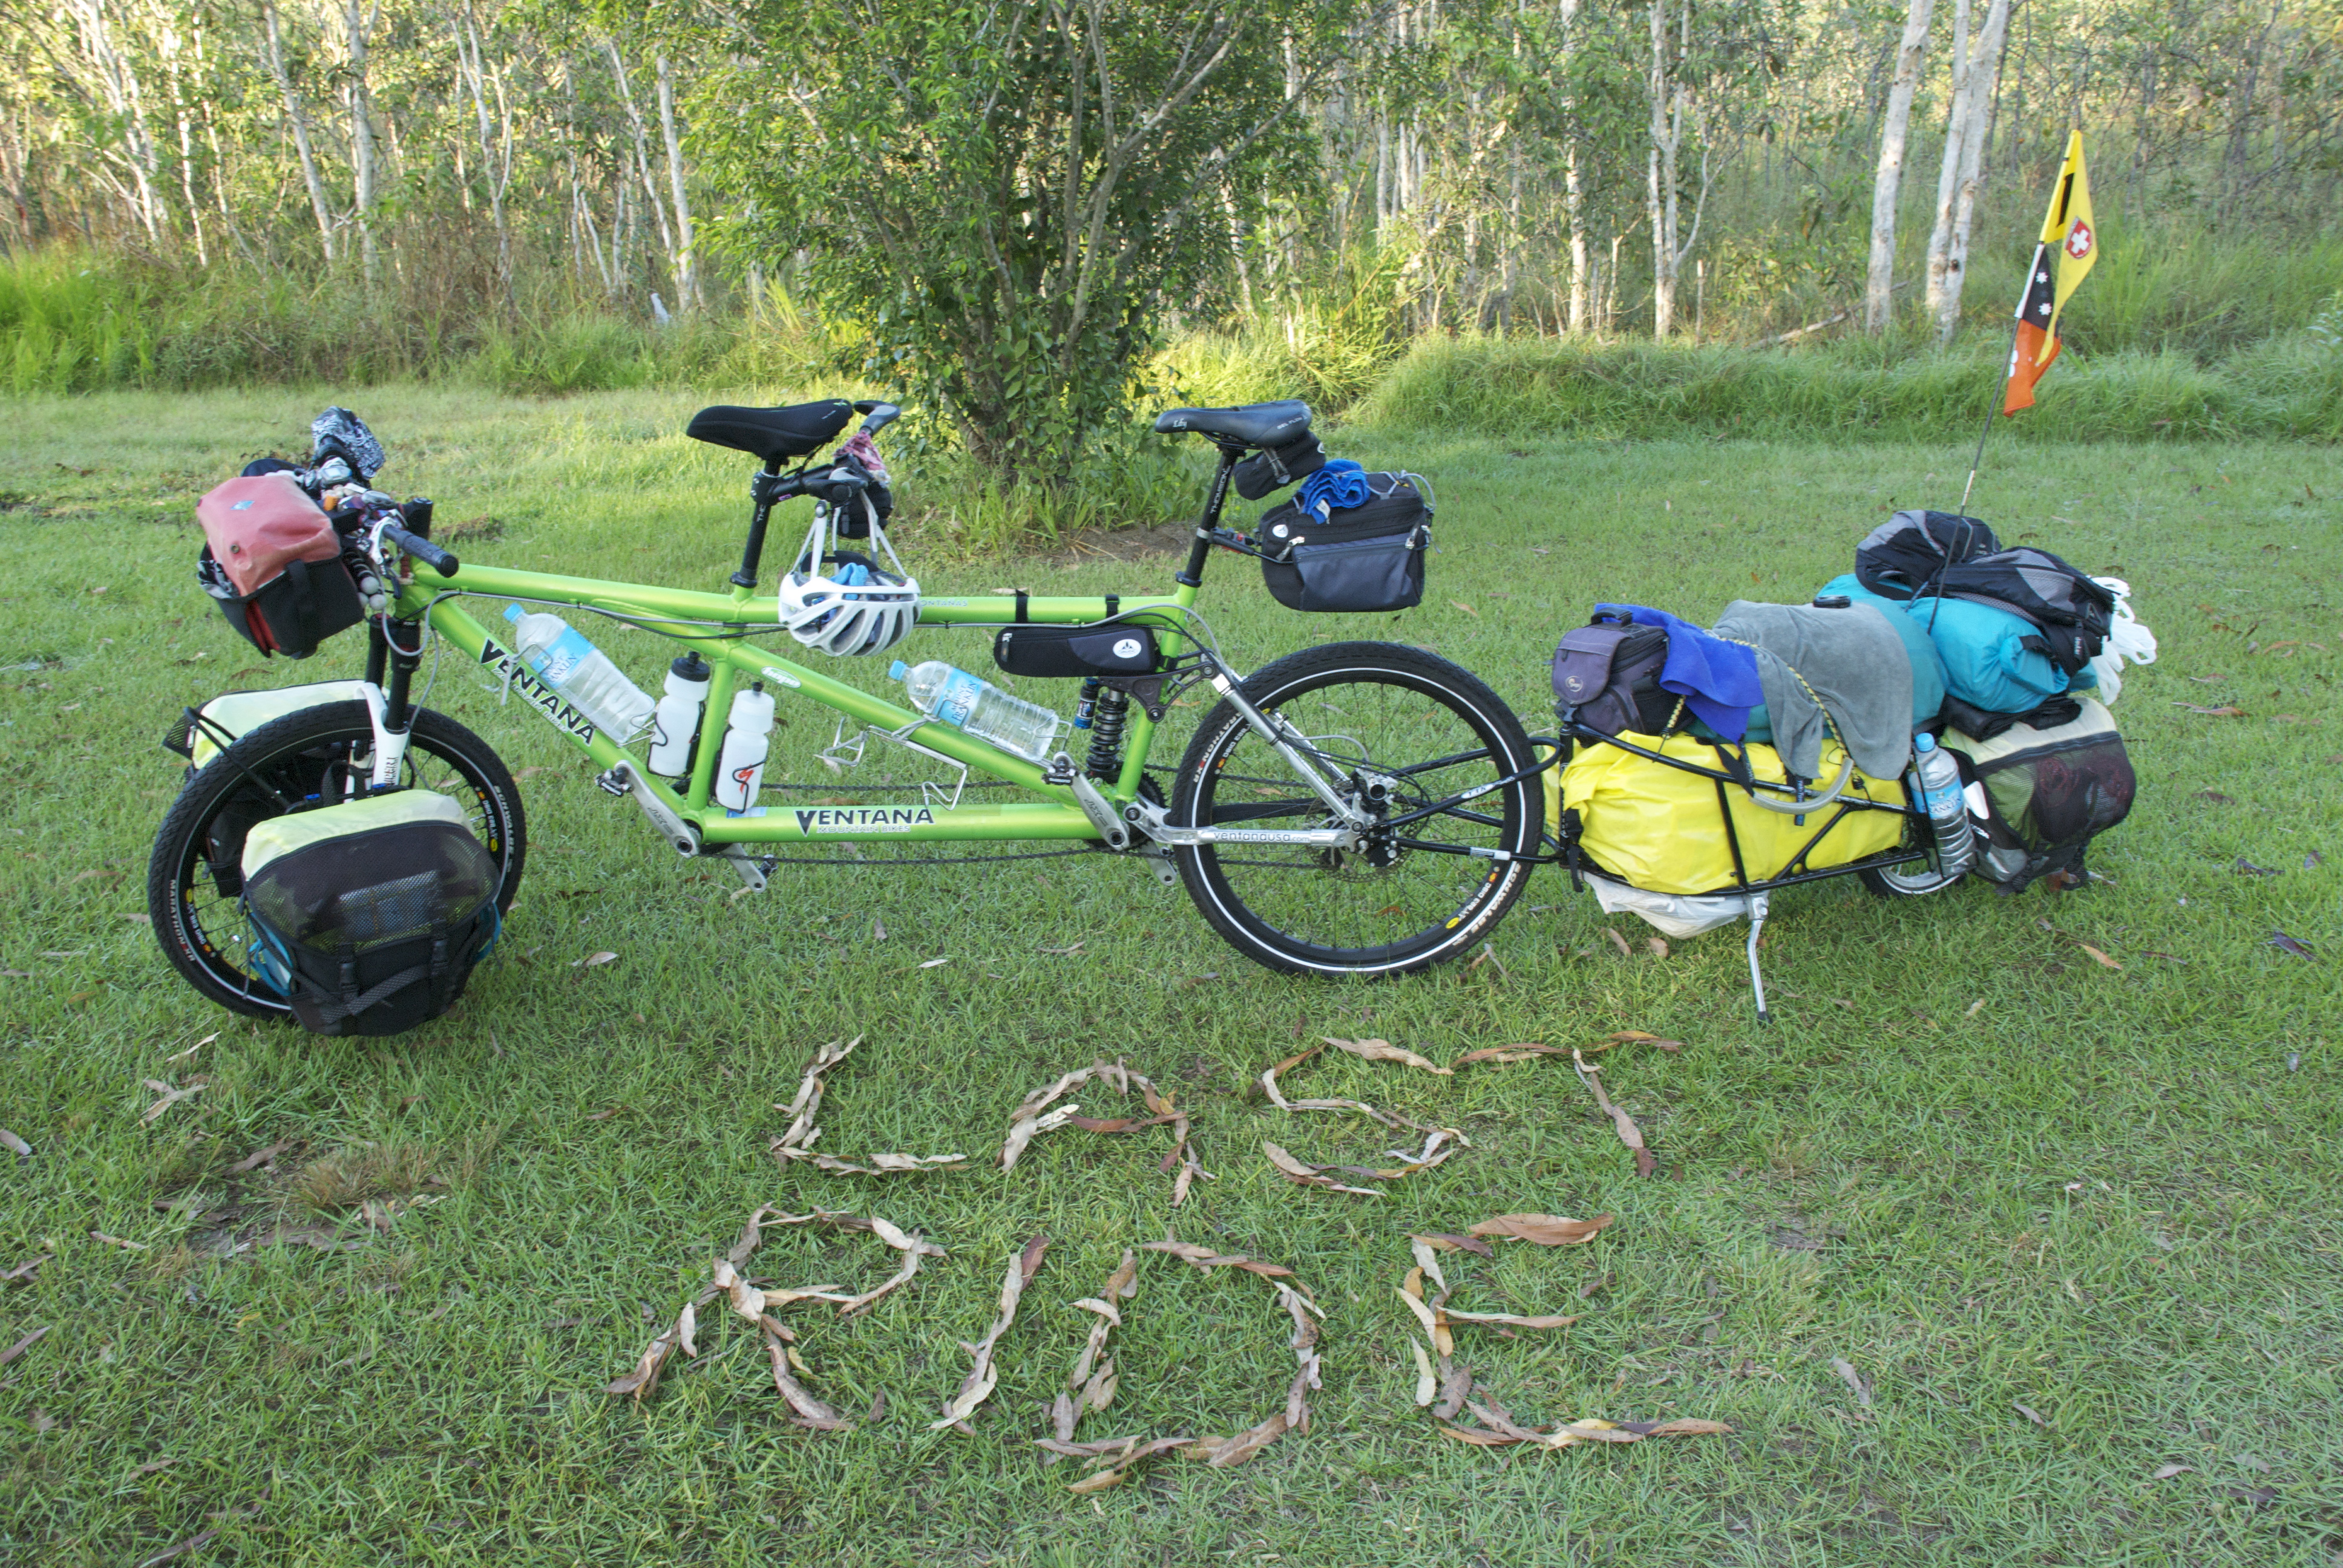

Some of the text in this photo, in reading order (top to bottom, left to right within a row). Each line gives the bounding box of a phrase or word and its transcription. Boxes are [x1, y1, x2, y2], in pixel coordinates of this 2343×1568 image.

[920, 598, 968, 607] ONTAÑAS
[479, 637, 597, 748] VENTANA
[951, 684, 967, 711] MOUNT
[951, 682, 977, 722] FRANKLIN
[1202, 711, 1243, 762] ARATHON
[794, 808, 935, 837] VENTANA
[816, 825, 879, 834] MOUNTAIN
[1213, 831, 1311, 843] ventanausa.com
[169, 879, 186, 944] MARATHON
[608, 1201, 1734, 1493] RIDE
